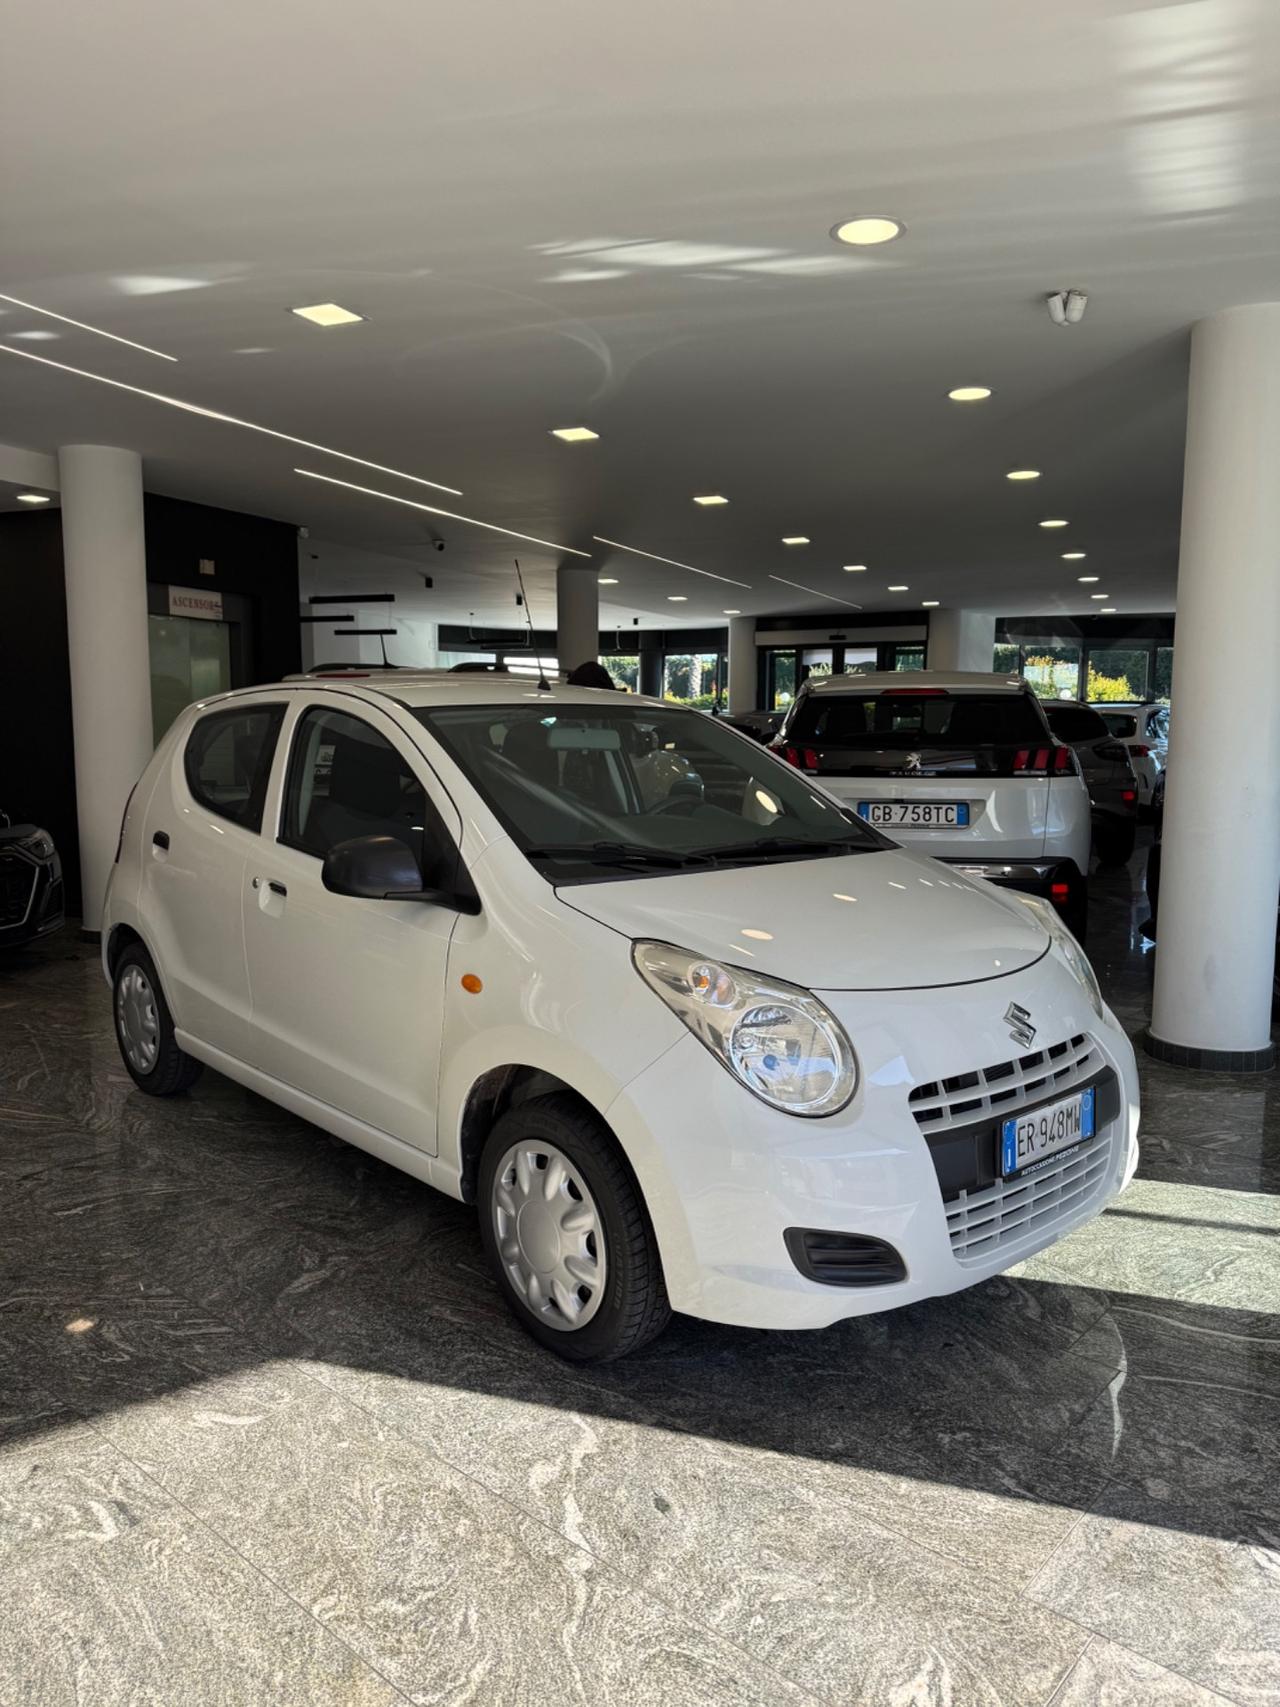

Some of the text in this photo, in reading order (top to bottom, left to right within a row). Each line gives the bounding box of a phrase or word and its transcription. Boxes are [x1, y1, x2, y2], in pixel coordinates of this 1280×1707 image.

[872, 805, 955, 823] GB 758TC
[1017, 1122, 1036, 1158] ER
[1040, 1103, 1081, 1148] 948MW
